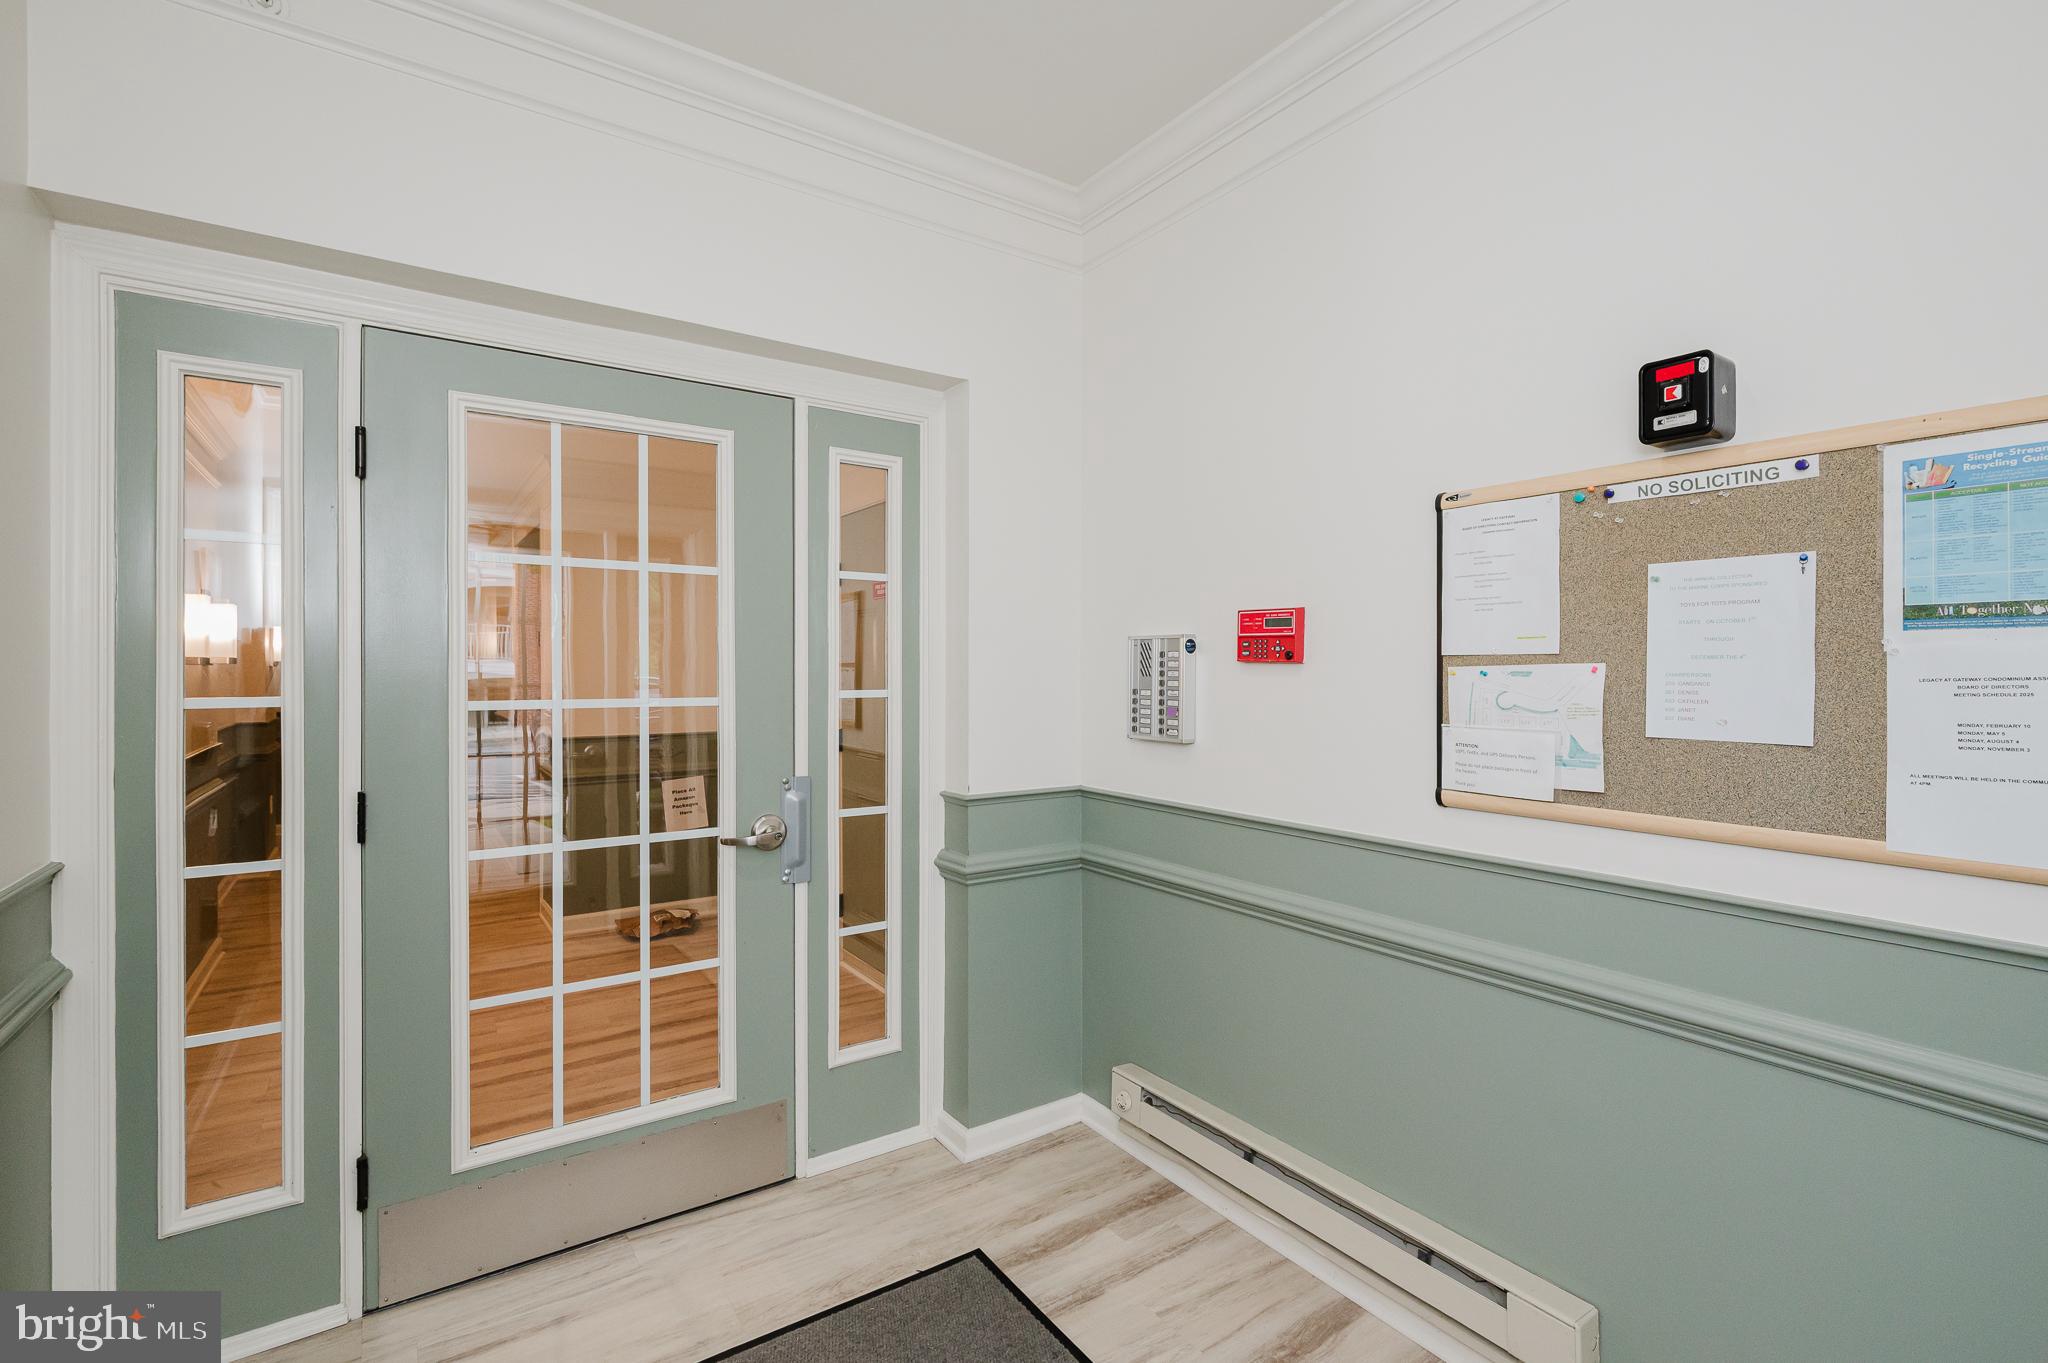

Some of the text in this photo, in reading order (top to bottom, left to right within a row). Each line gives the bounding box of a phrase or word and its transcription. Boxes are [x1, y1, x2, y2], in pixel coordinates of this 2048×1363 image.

[1963, 459, 2018, 471] Recycling
[1638, 467, 1780, 497] NO SOLICITING
[1936, 605, 1955, 616] All
[1957, 603, 2019, 617] Together
